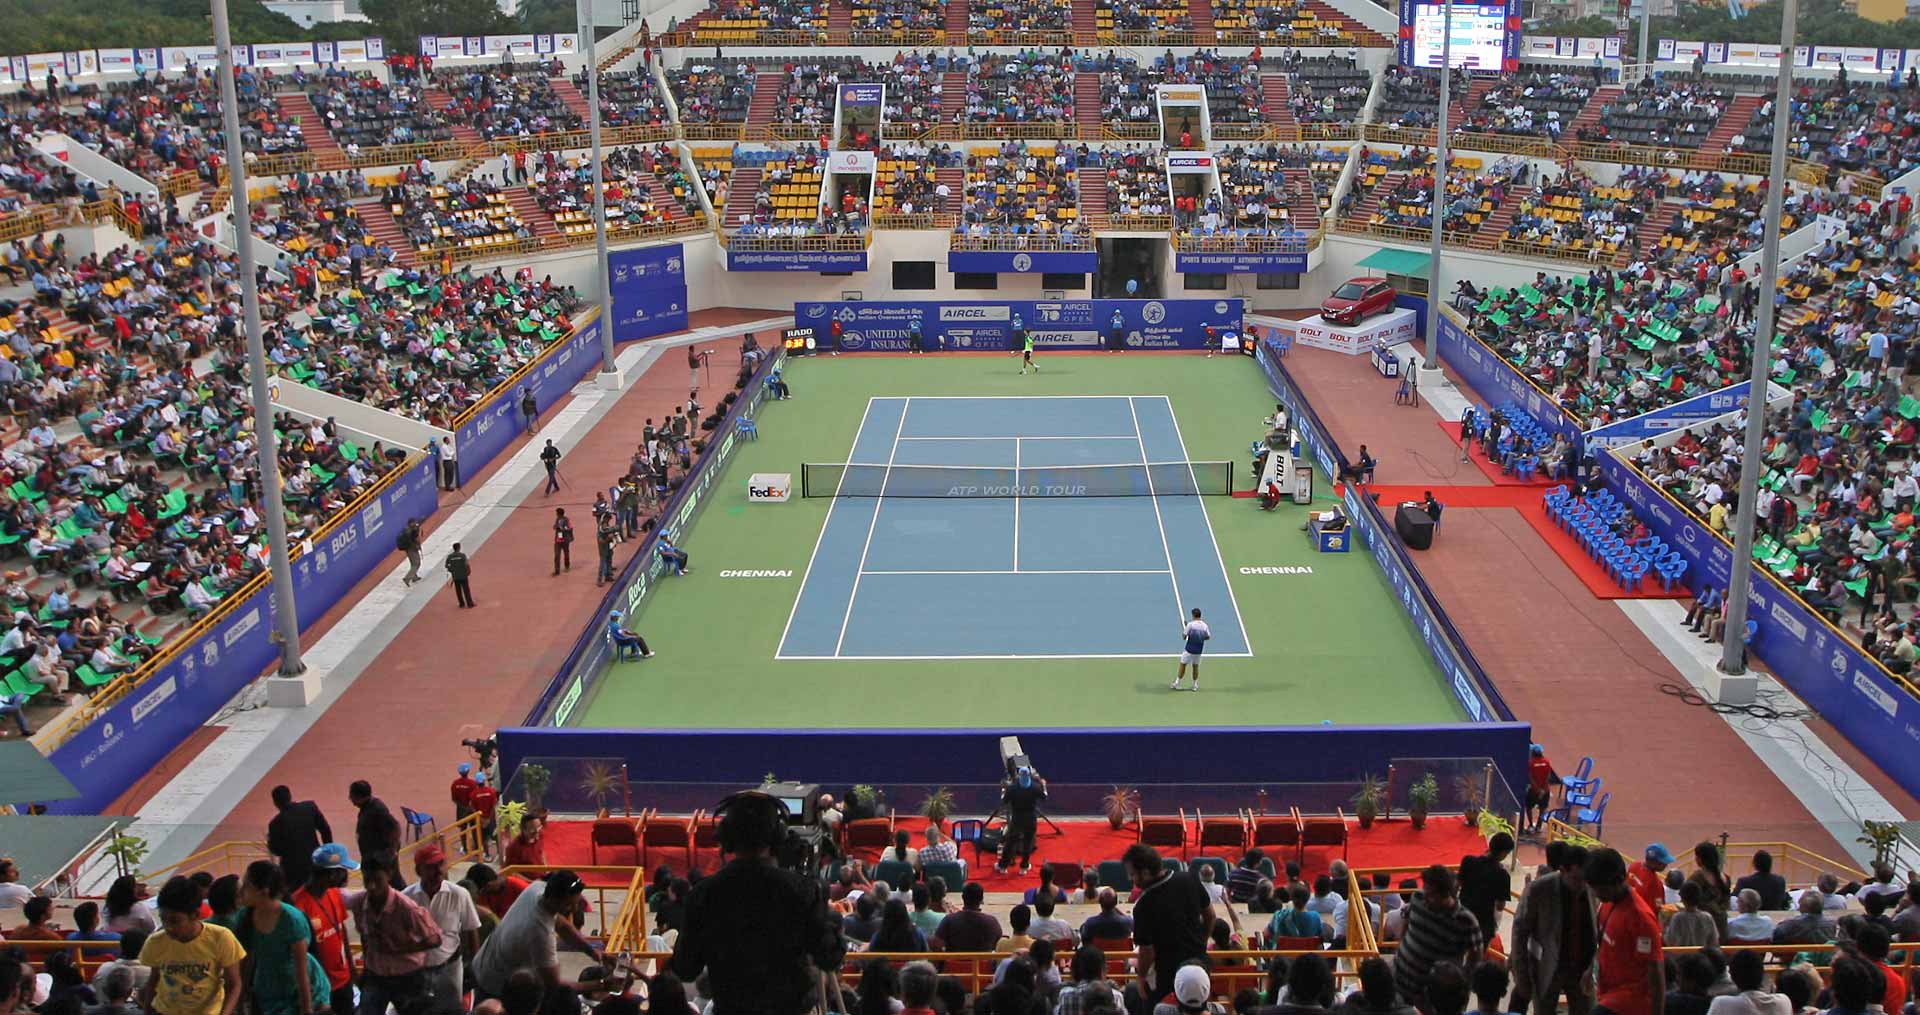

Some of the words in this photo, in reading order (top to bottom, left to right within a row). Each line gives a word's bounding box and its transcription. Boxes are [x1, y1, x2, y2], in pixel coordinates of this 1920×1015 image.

[1063, 303, 1092, 311] AIRCEL
[943, 309, 987, 318] AIRCEL
[787, 328, 813, 337] RADO
[865, 329, 897, 339] UNITED
[976, 329, 1003, 337] AIRCEL
[1300, 327, 1322, 336] BOLT
[1034, 333, 1075, 342] AIRCEL
[1329, 332, 1352, 343] BOLT
[1276, 454, 1285, 487] BOLT
[750, 486, 785, 498] FedEx
[947, 486, 979, 496] ATP
[983, 486, 1040, 496] WORLD
[1045, 486, 1087, 495] TOUR
[331, 523, 357, 555] BOLS
[719, 569, 793, 578] CHENNAI
[1239, 566, 1313, 574] CHENNAI
[1856, 675, 1882, 701] AIRCEL
